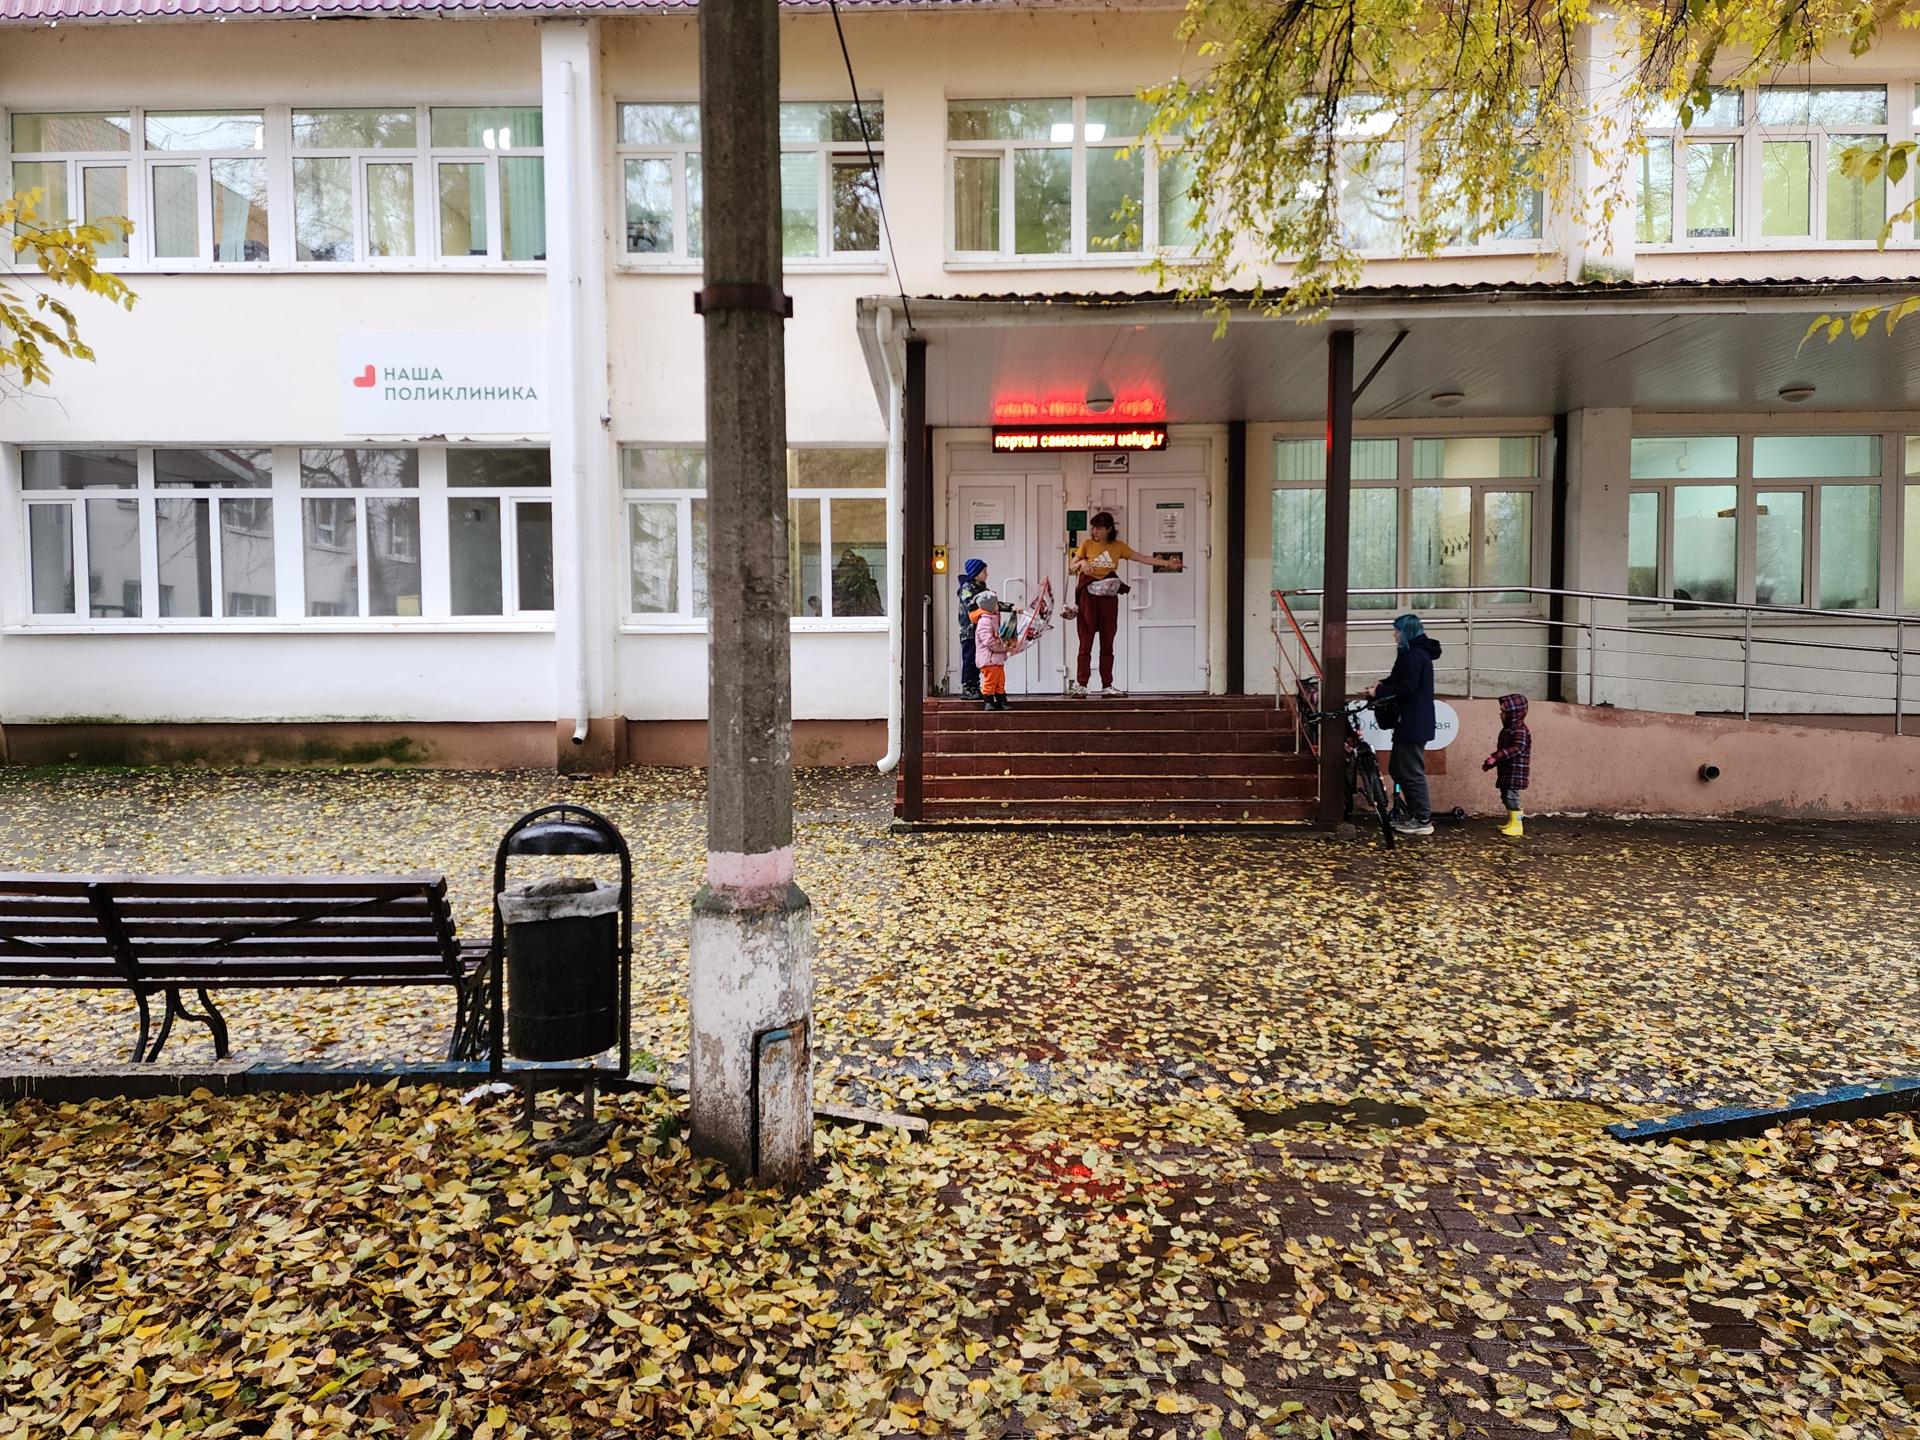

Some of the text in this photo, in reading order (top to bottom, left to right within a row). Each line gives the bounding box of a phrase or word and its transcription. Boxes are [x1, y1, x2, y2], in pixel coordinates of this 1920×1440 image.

[384, 367, 443, 381] НАША
[385, 386, 538, 401] ПОЛИКЛИНИКА
[995, 434, 1038, 451] портал
[1040, 433, 1115, 448] самозаписи
[1090, 560, 1116, 569] adidas
